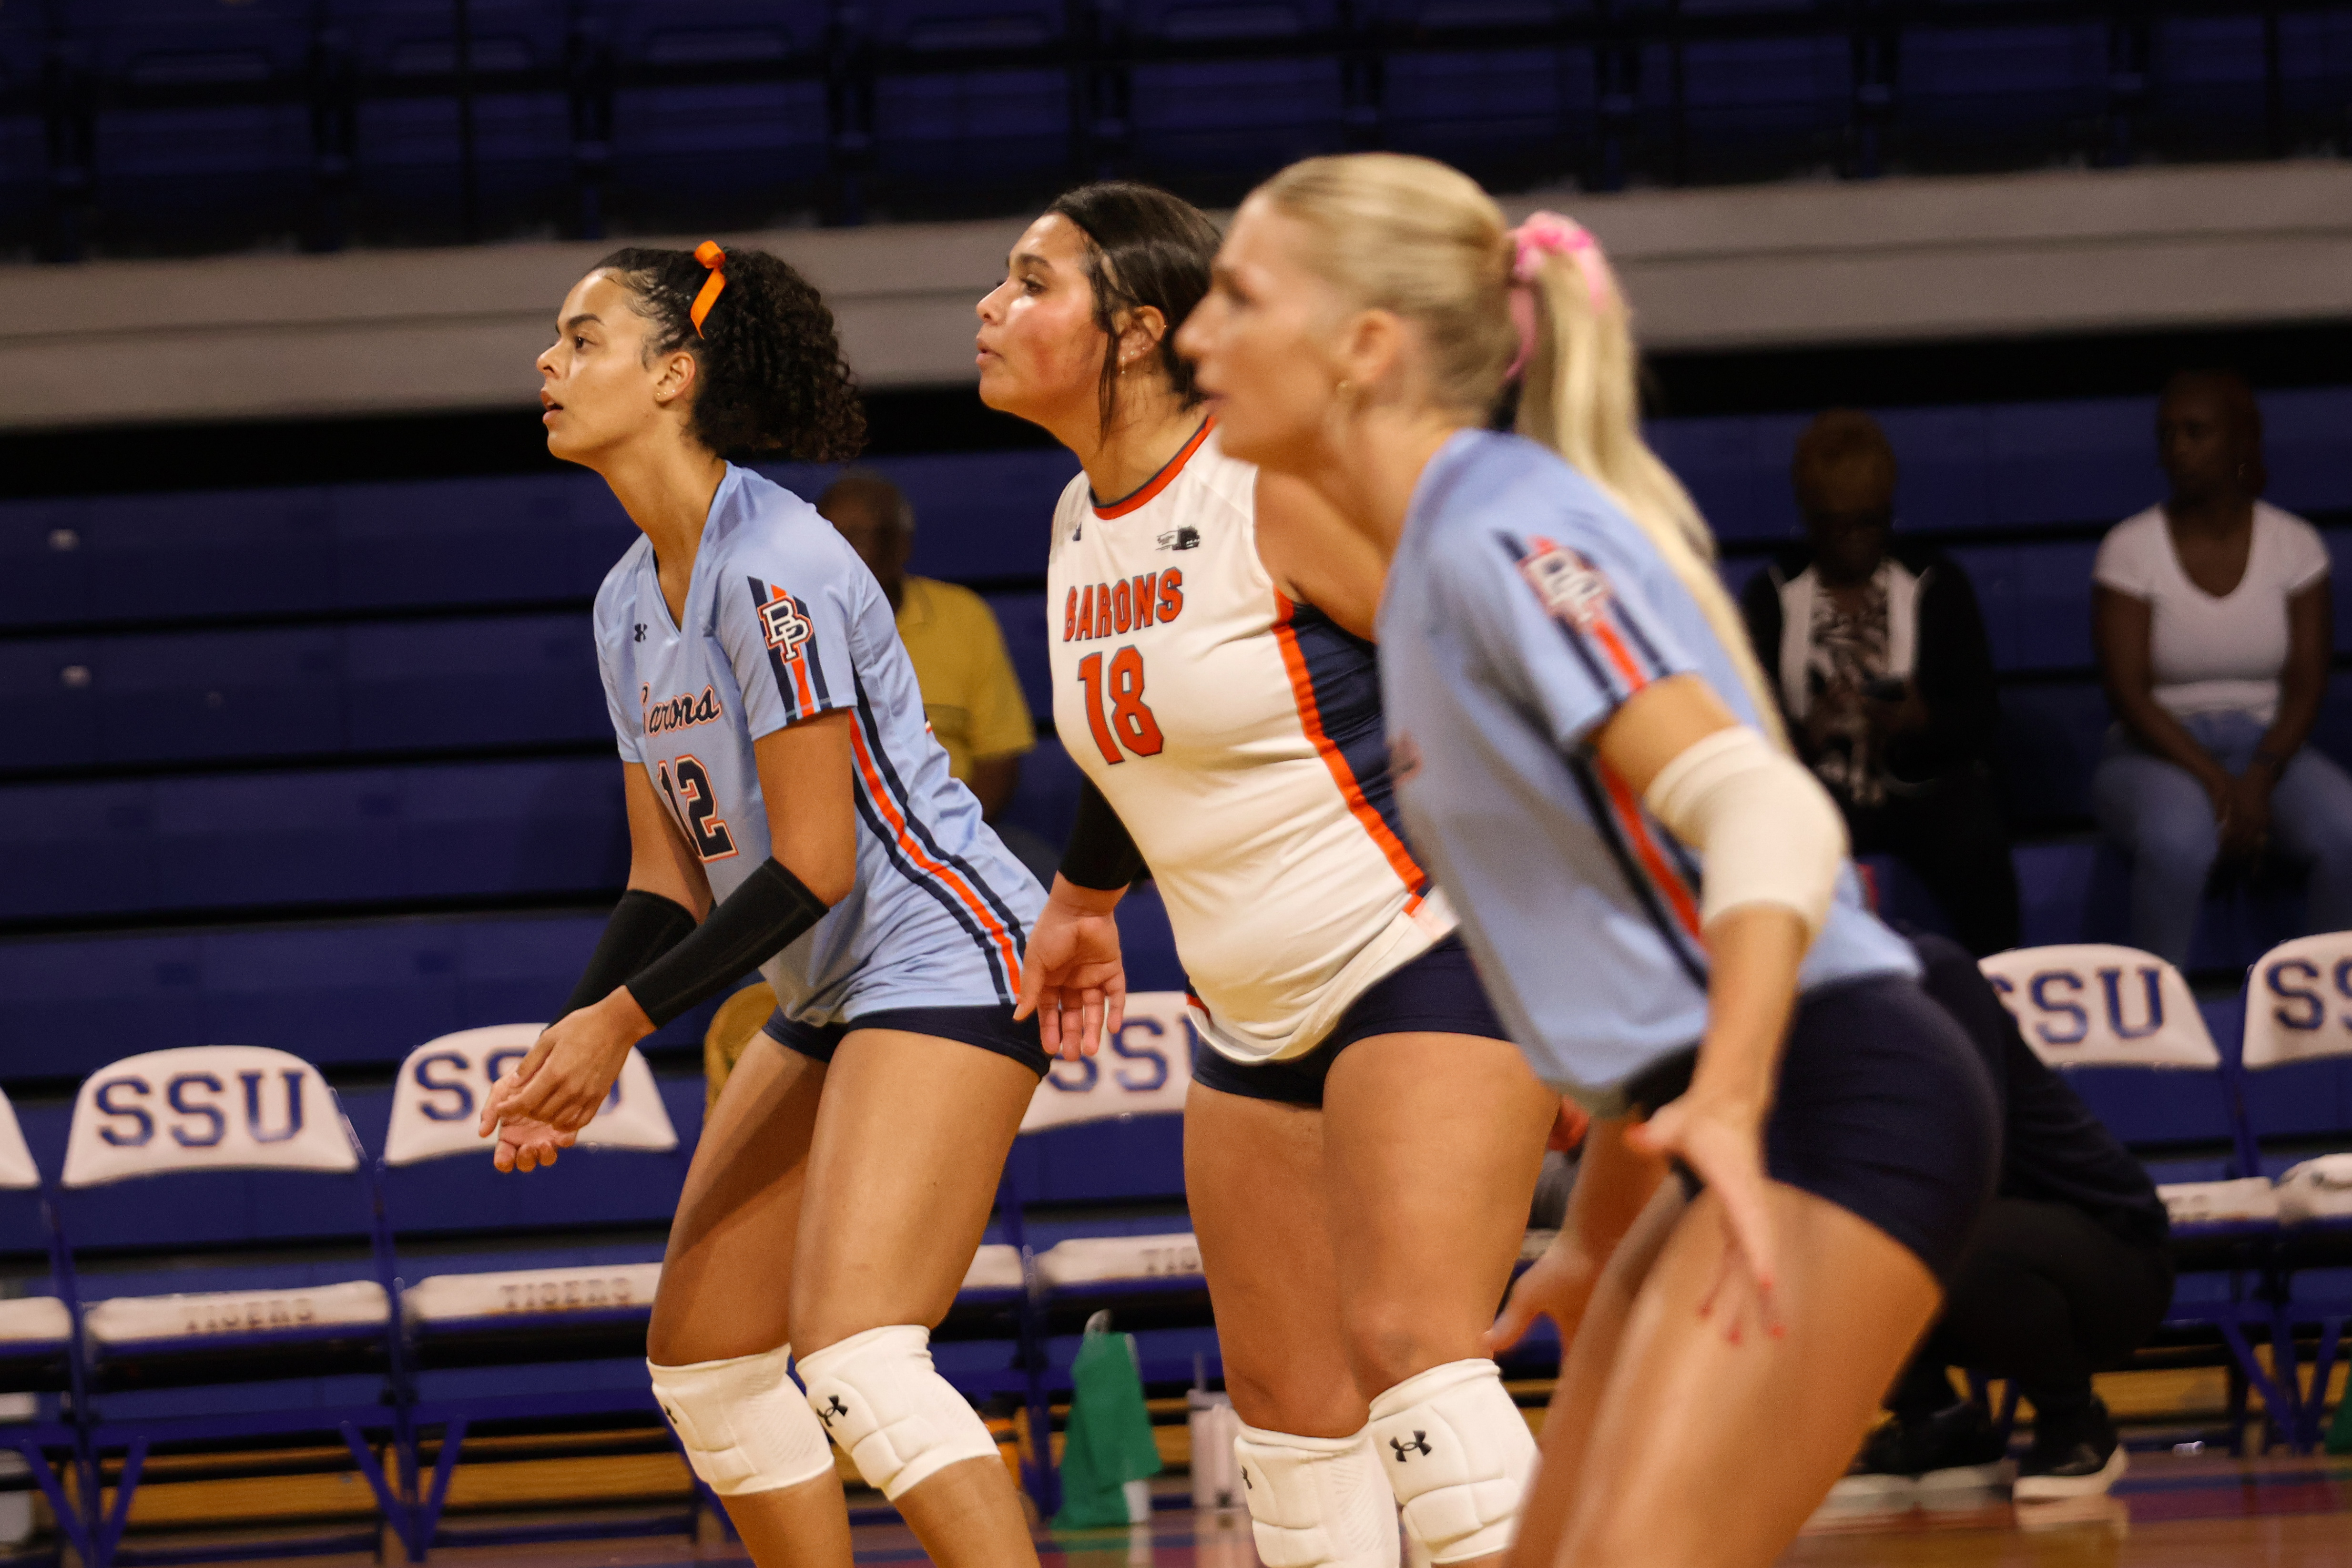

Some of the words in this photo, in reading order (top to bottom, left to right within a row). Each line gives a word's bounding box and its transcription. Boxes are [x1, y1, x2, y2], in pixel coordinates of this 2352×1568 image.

[757, 595, 814, 663] BP
[1063, 566, 1184, 642] BARONS
[641, 682, 723, 736] arons
[1078, 645, 1164, 765] 18
[658, 754, 739, 863] 12
[95, 1069, 306, 1147] SSU
